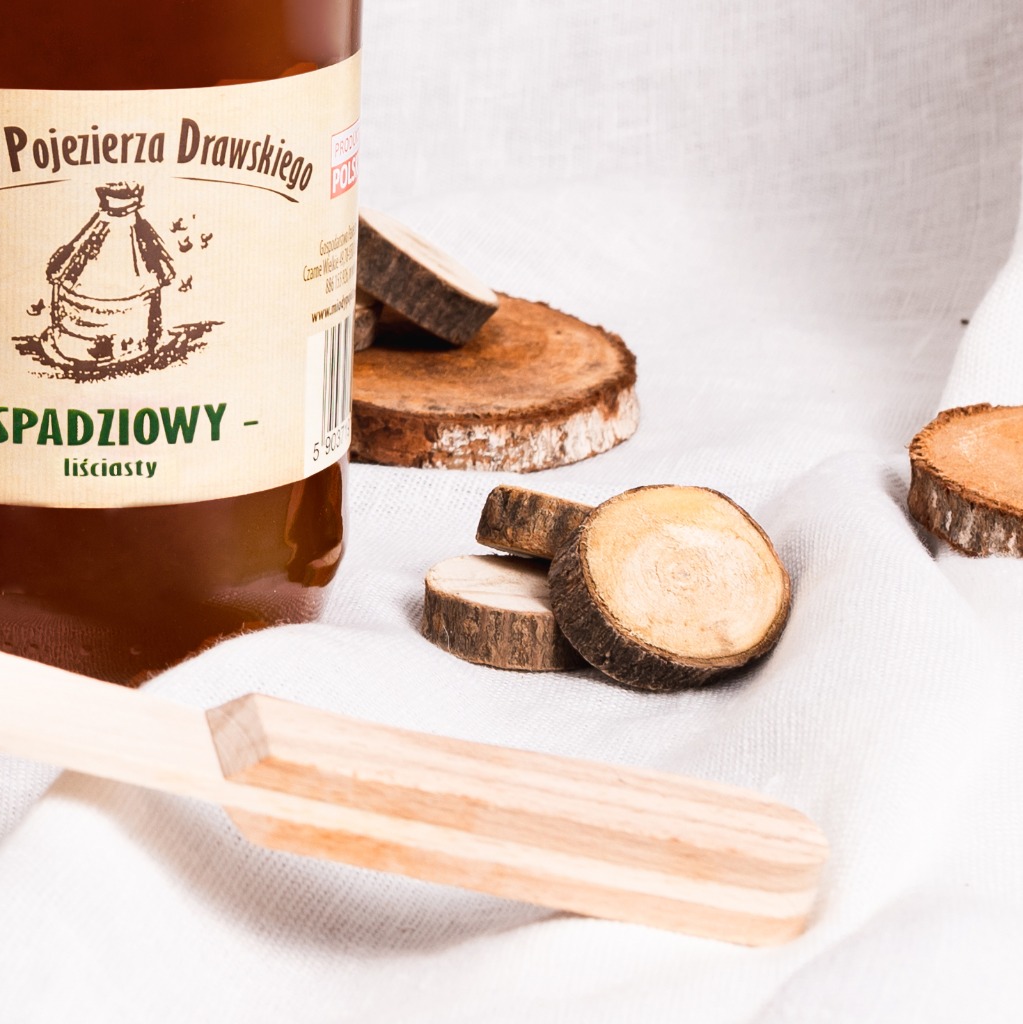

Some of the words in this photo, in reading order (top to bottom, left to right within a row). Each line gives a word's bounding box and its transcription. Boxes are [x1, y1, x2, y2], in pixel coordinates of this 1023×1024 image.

[3, 124, 165, 174] Pojezierza
[177, 117, 313, 192] Drawskiego
[313, 441, 320, 462] 5
[63, 457, 158, 478] liściasty
